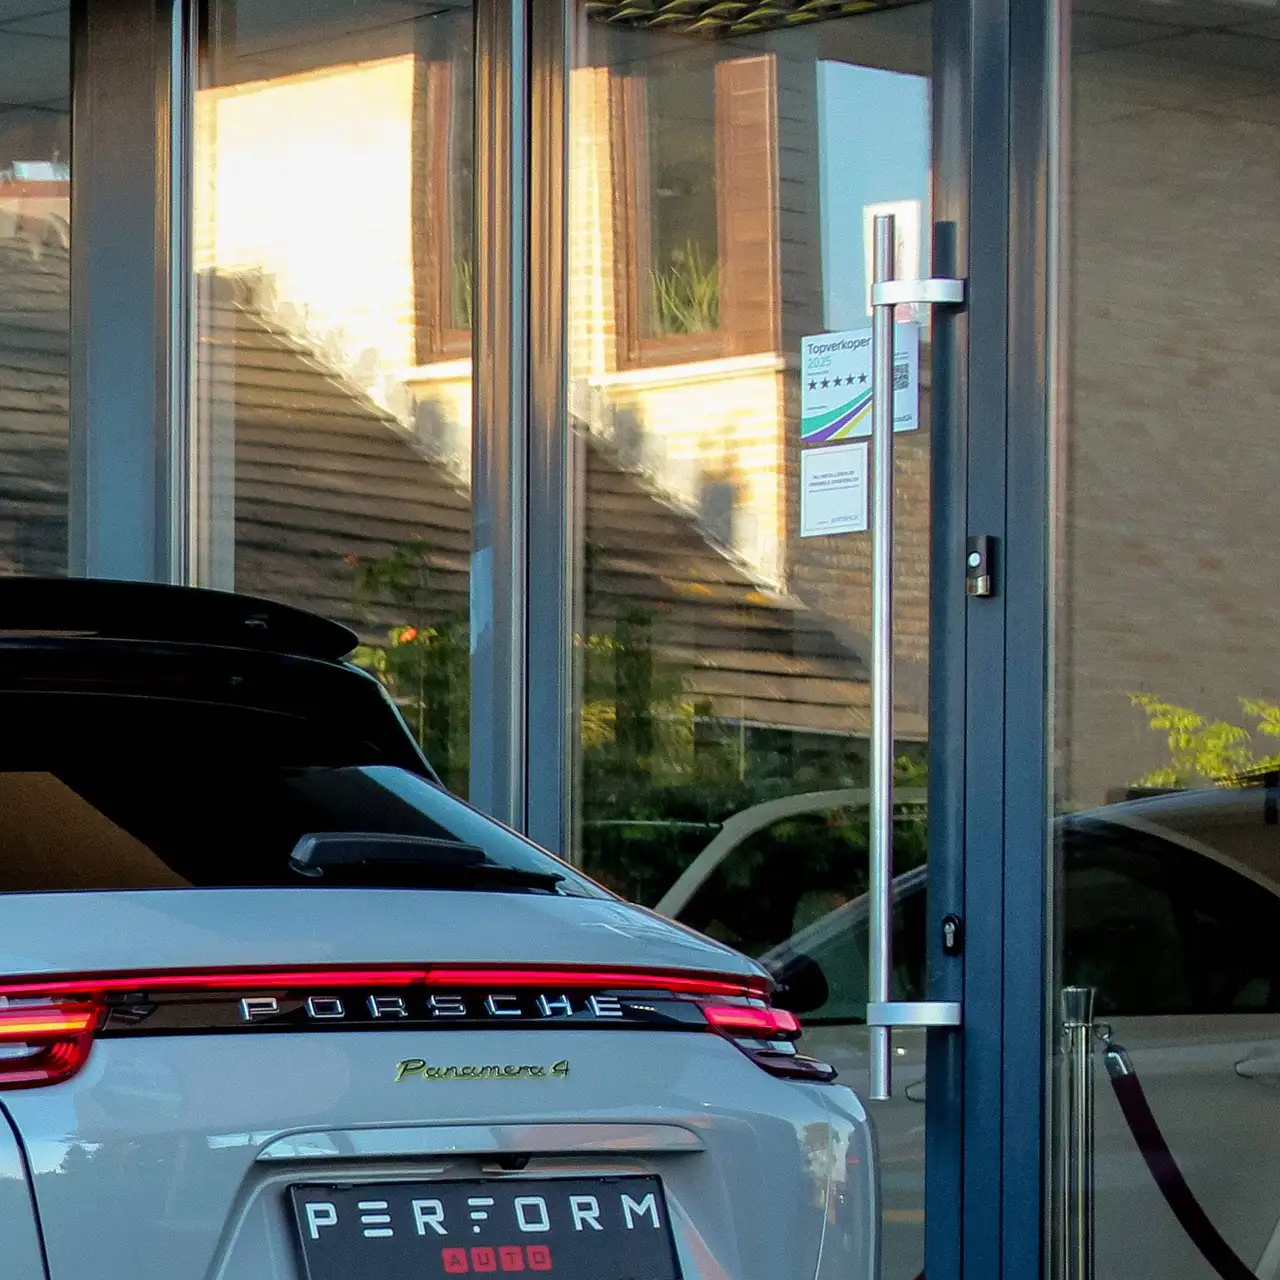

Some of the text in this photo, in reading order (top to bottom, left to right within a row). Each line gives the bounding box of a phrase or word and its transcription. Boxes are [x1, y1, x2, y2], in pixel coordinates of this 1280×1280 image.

[807, 337, 872, 355] Topverkoper
[807, 355, 832, 369] 2025
[241, 994, 623, 1021] PORSCHE
[395, 1058, 571, 1081] Panamera 4
[305, 1193, 661, 1239] PERFORM
[445, 1248, 549, 1270] AUTO
